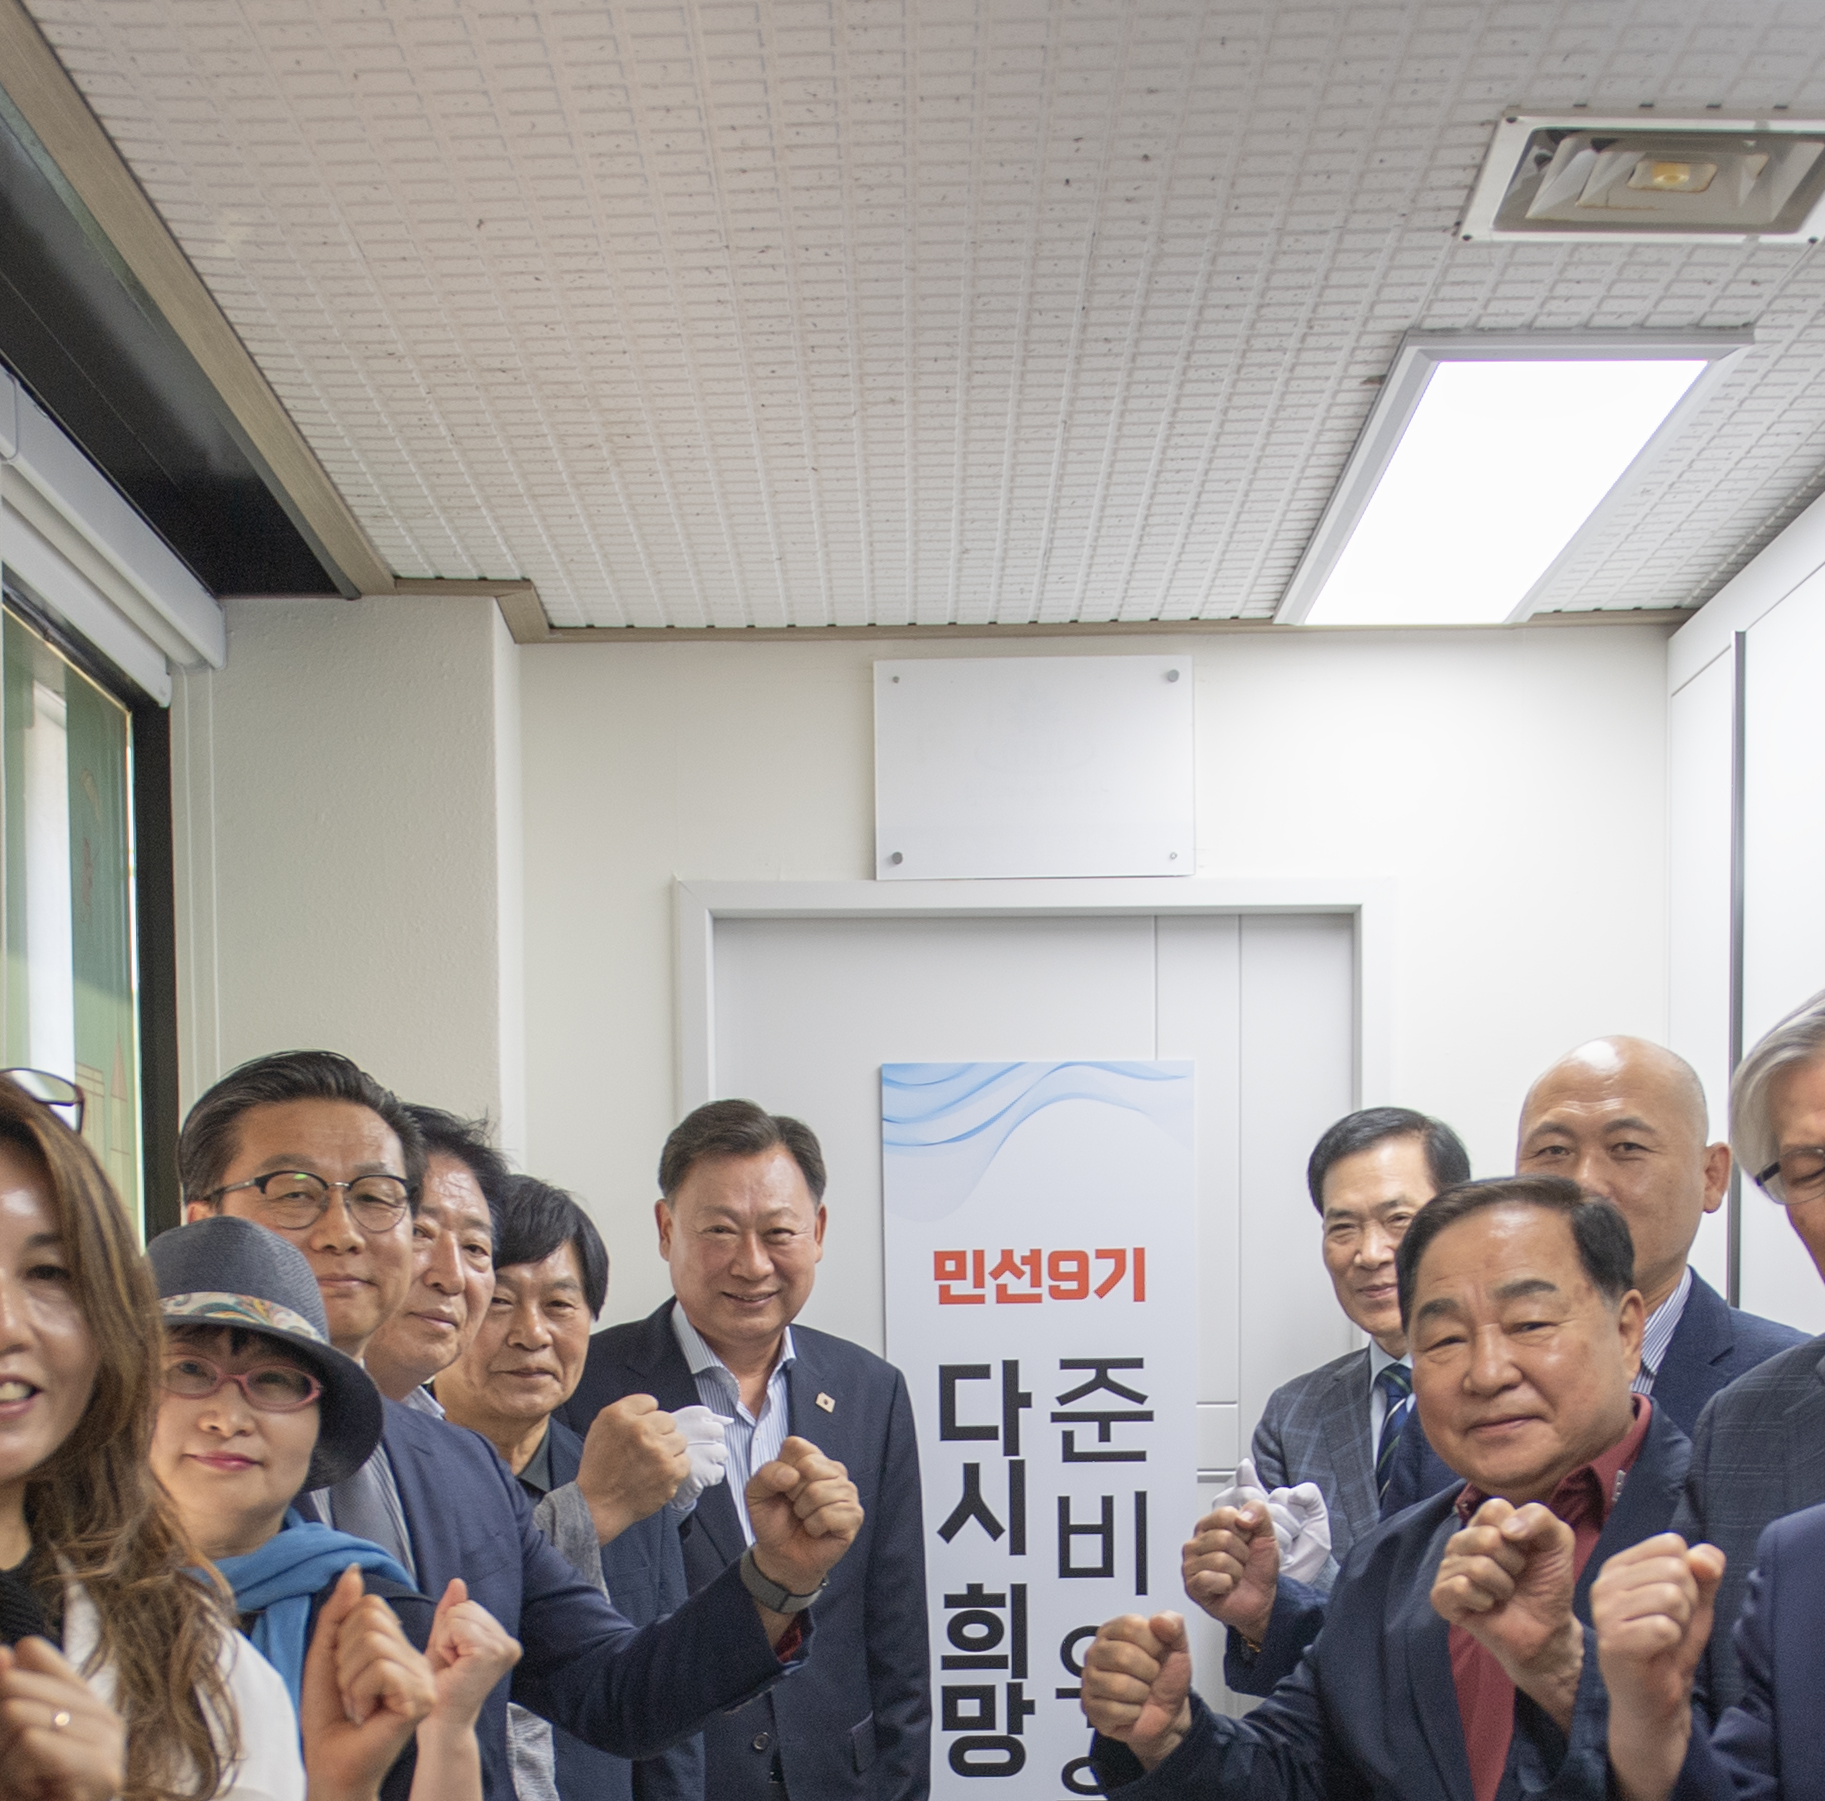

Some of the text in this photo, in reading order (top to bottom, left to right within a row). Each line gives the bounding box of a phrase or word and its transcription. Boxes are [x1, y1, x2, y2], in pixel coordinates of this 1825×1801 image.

[931, 1246, 1147, 1306] 민선9기
[937, 1358, 1033, 1557] 다시
[939, 1582, 1036, 1779] 희망
